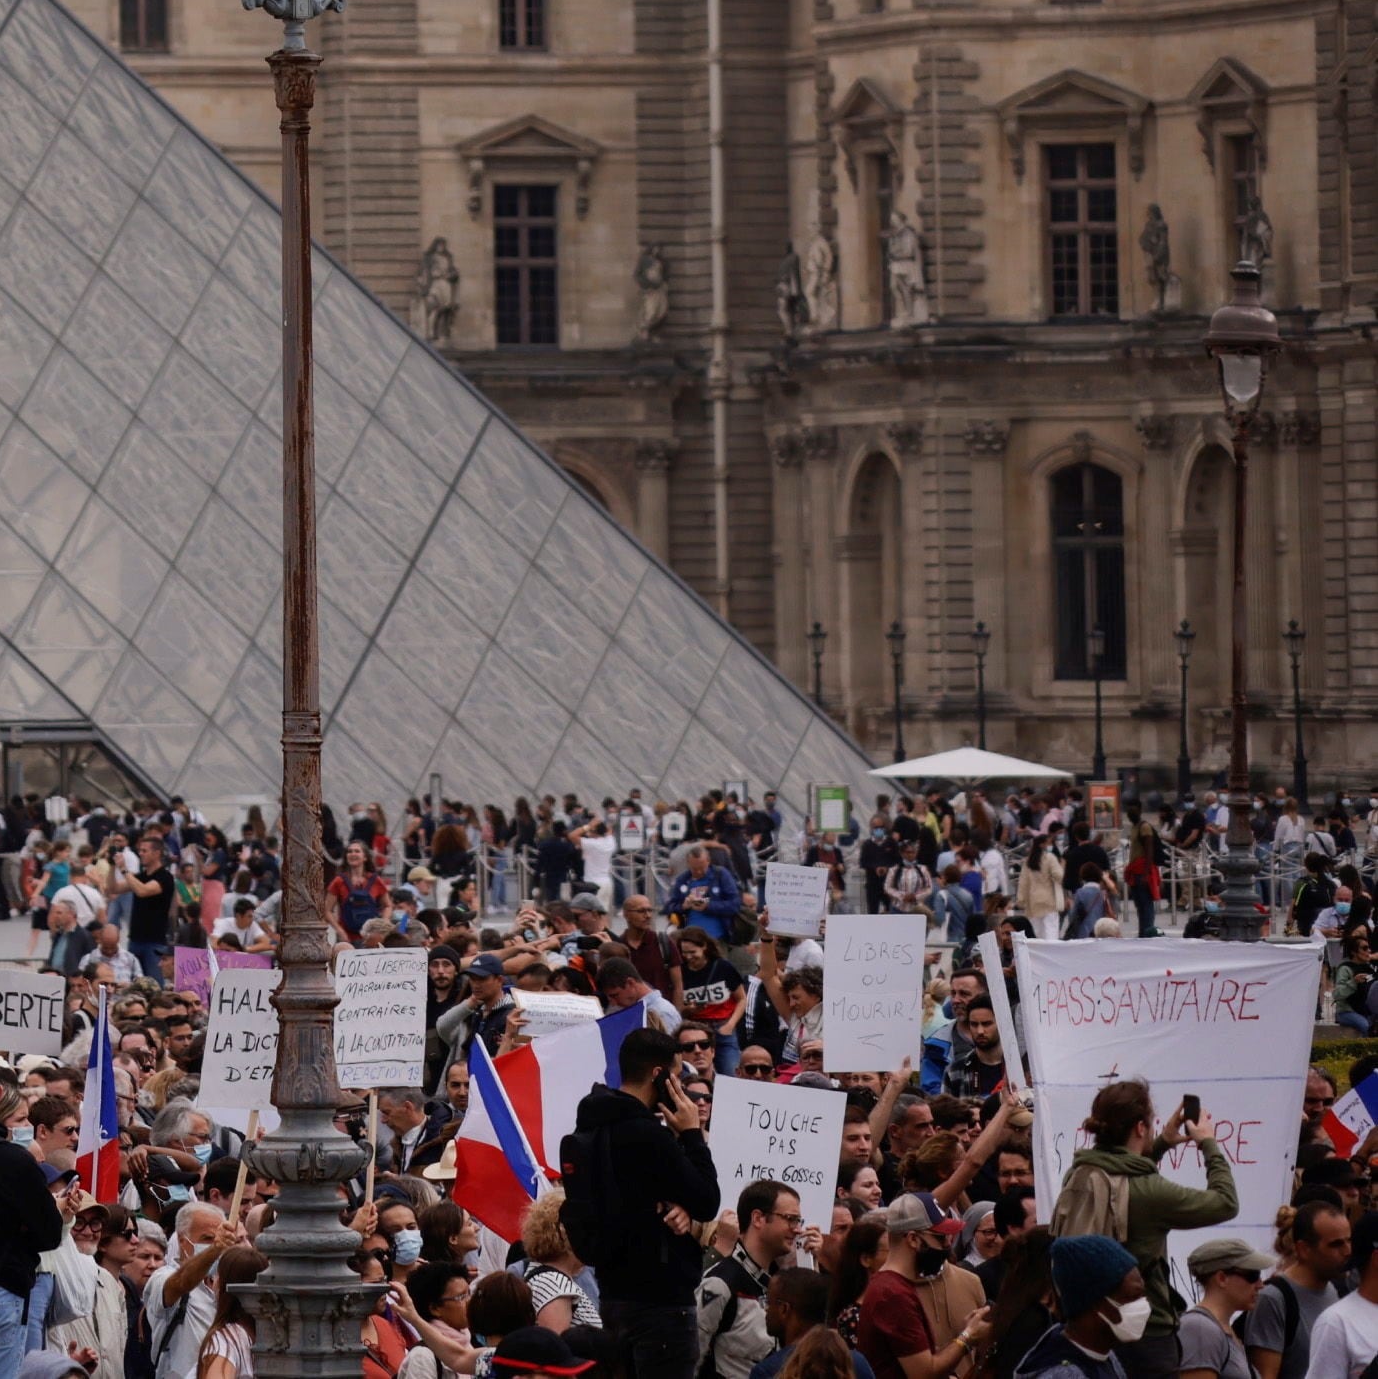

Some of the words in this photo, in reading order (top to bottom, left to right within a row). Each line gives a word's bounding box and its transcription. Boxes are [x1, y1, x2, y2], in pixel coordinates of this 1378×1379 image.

[844, 935, 914, 965] LIBRES
[340, 959, 367, 978] LOIS
[862, 974, 887, 987] OU
[213, 1032, 233, 1053] LA
[747, 1102, 823, 1134] TOUCHE
[768, 1135, 797, 1155] PAS
[751, 1164, 775, 1181] MES
[781, 1165, 824, 1186] GOSSES
